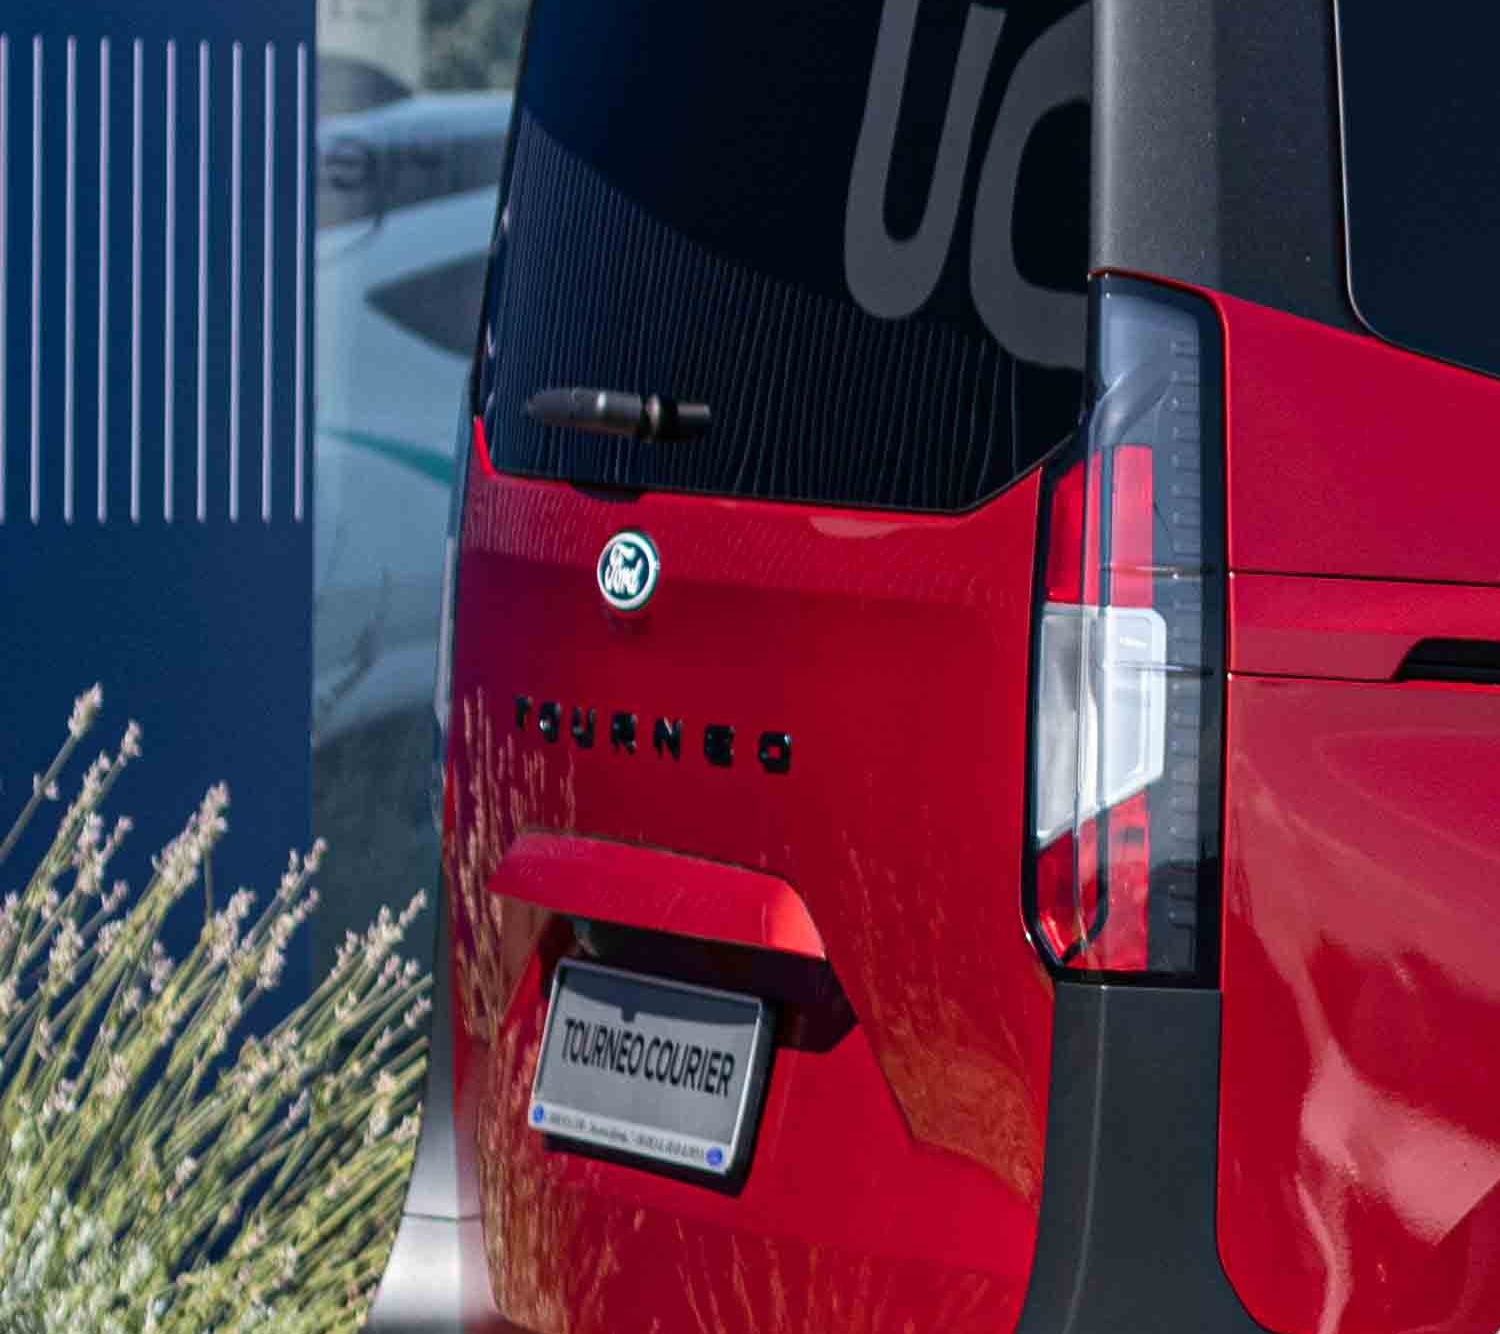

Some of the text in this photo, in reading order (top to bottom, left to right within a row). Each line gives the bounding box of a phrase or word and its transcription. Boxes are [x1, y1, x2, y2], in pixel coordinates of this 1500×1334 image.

[512, 693, 792, 774] TOURNEO
[562, 1018, 735, 1098] TOURNEO COURIER
